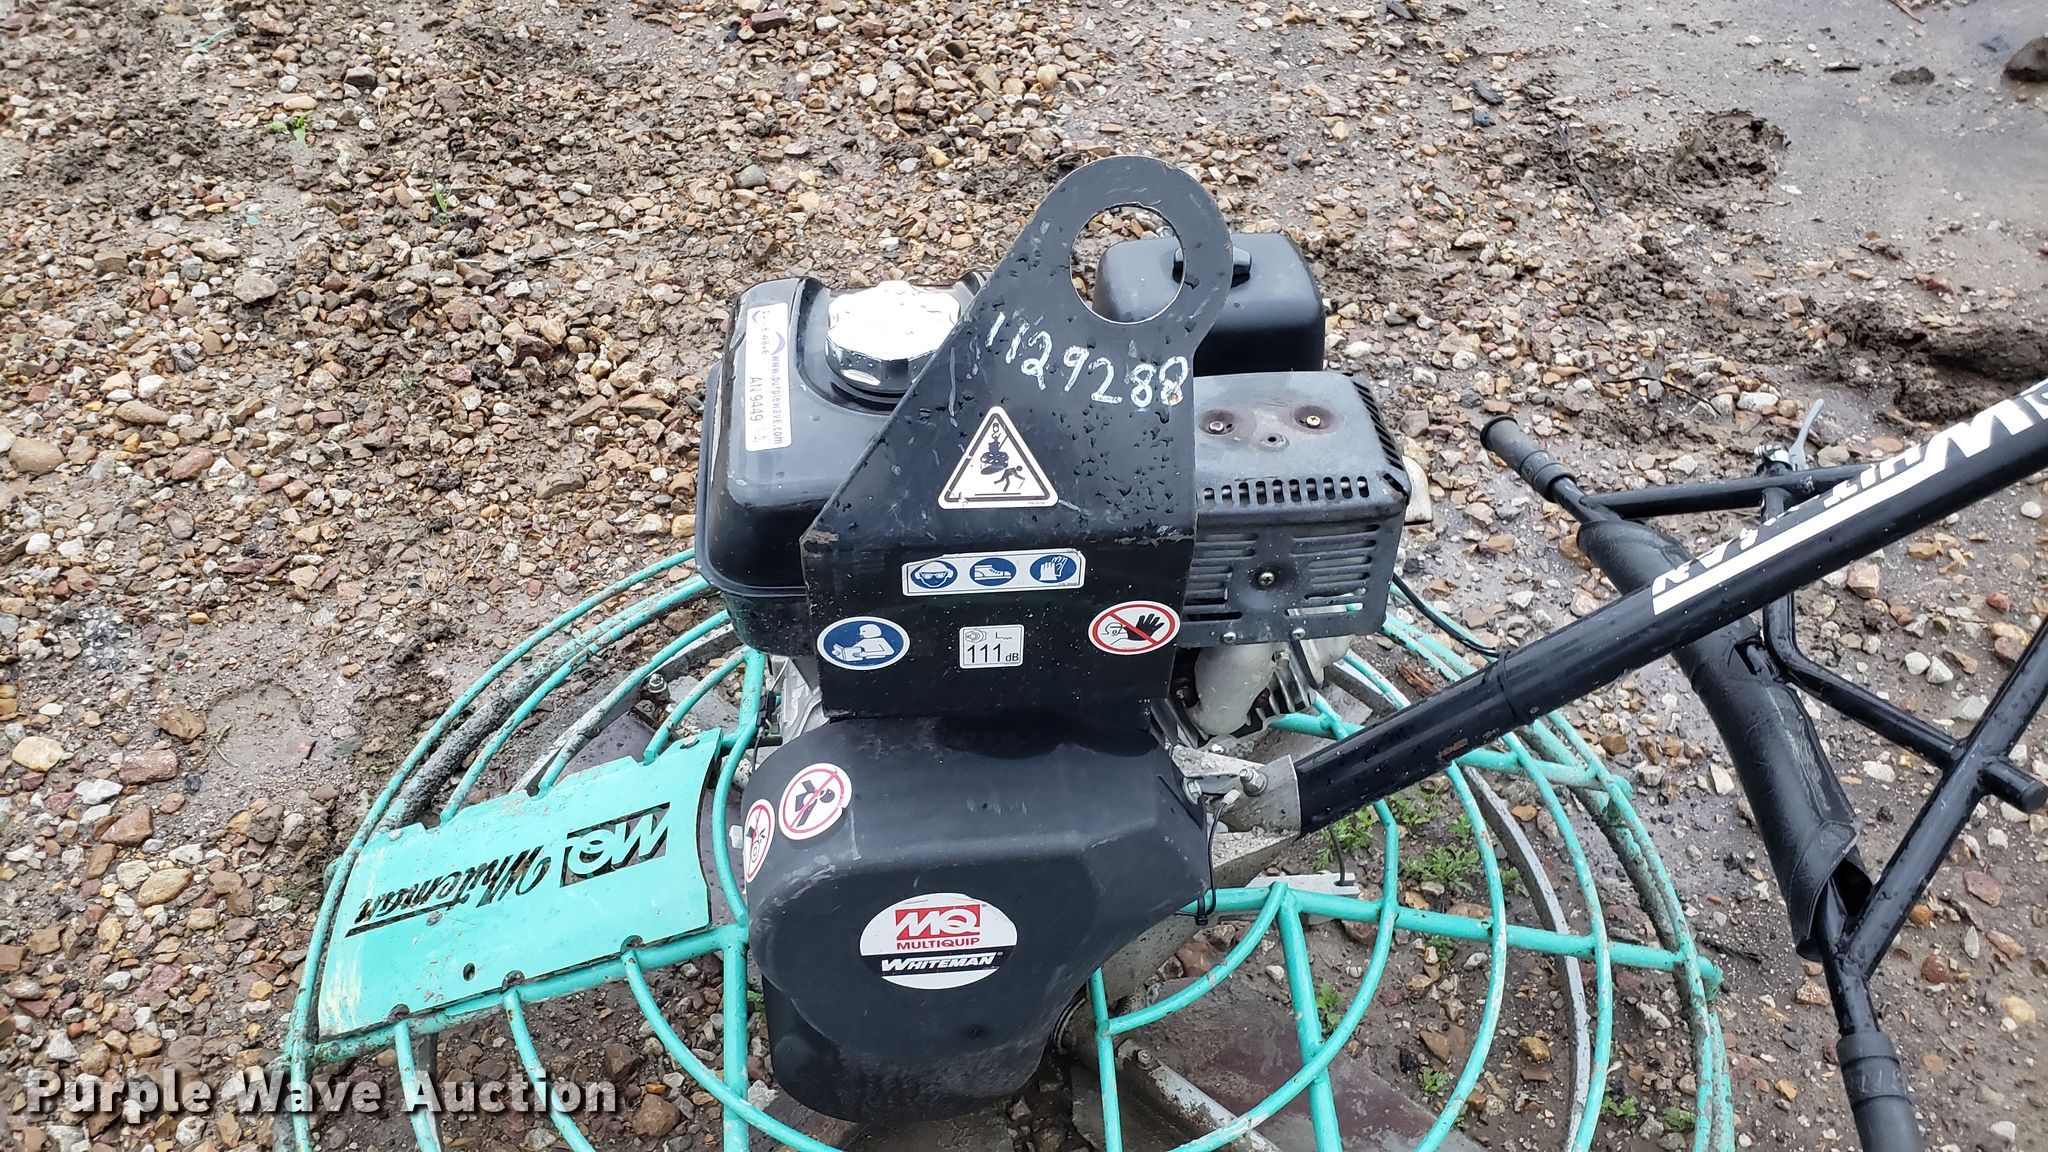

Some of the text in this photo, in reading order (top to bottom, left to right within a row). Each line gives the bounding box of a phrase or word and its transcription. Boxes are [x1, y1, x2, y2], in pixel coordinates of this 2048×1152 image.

[985, 311, 1188, 408] 1129288
[750, 394, 764, 422] 9449
[769, 356, 783, 445] www.purplewave.com
[967, 643, 1019, 664] 111 dB
[344, 806, 671, 937] MQ Whiteman
[896, 906, 980, 939] MQ
[896, 937, 980, 951] MULTIQUIP
[881, 952, 997, 972] WHITEMAN
